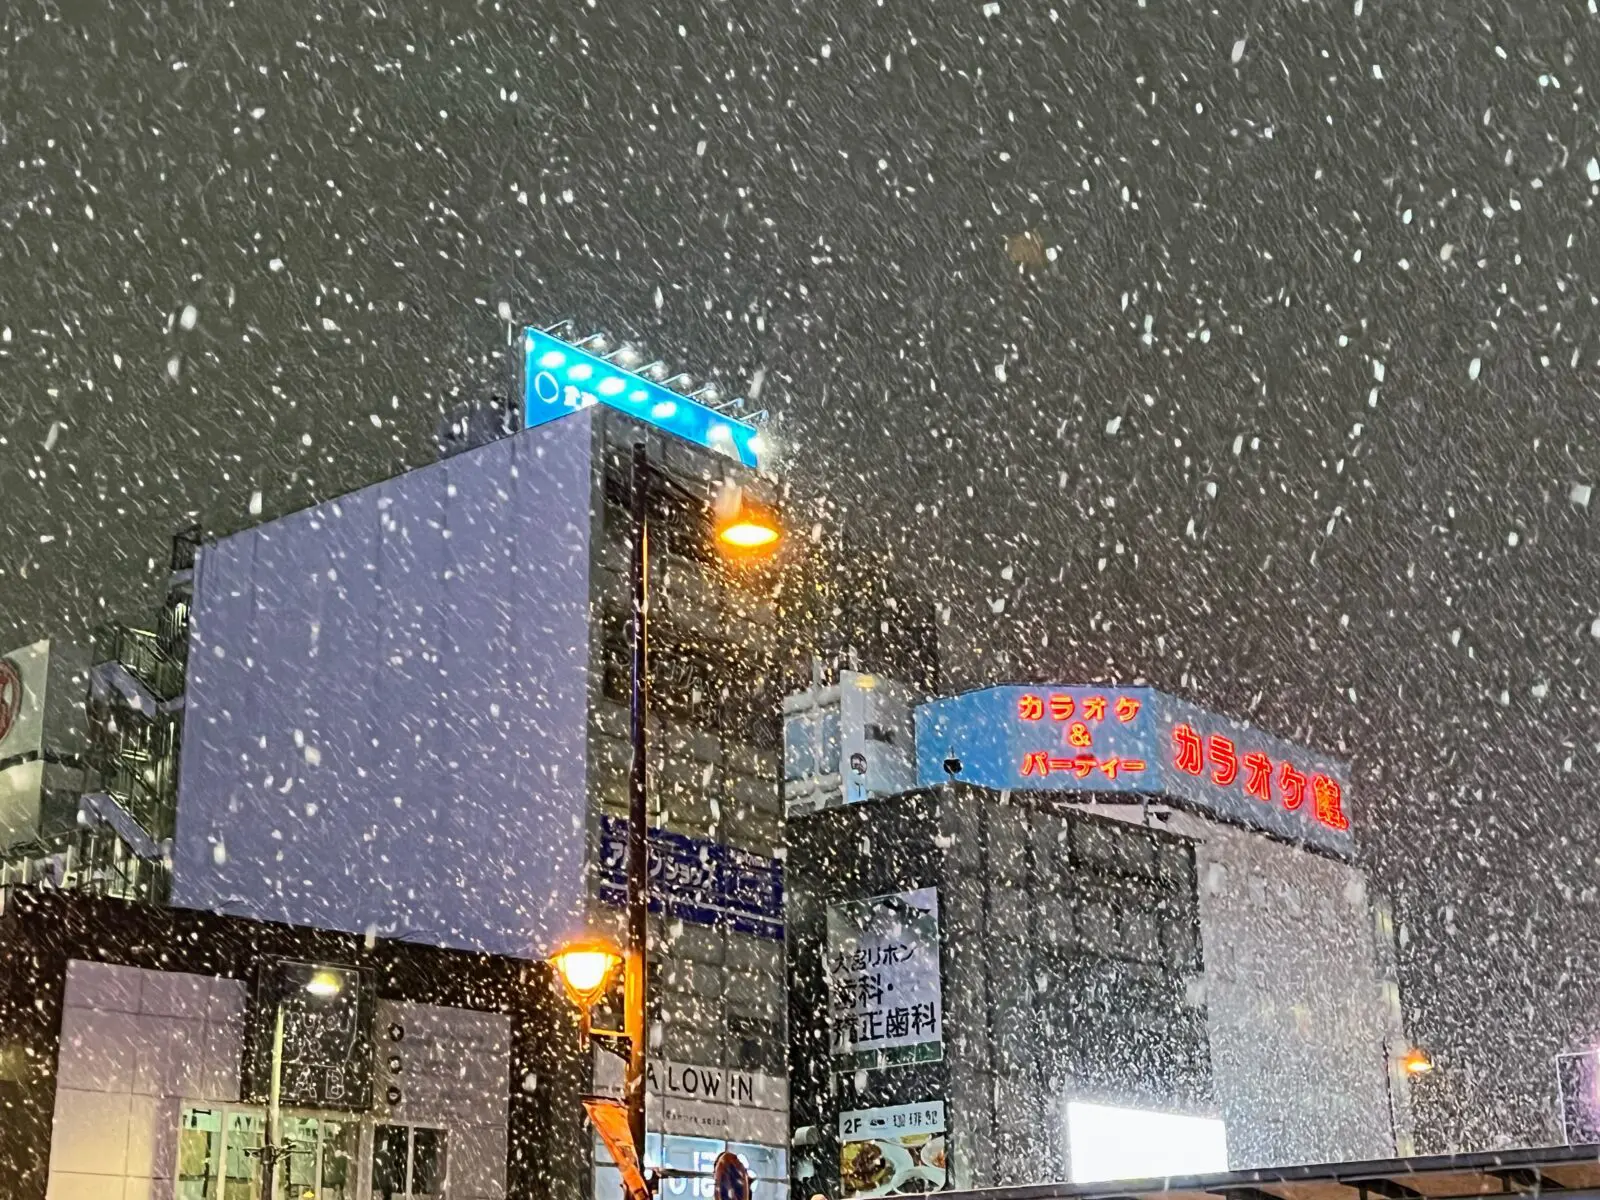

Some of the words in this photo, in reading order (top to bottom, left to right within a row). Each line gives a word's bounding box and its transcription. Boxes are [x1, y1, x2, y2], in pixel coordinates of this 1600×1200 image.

[1019, 693, 1141, 722] カラオケ
[1068, 721, 1091, 747] &
[1022, 751, 1147, 779] パーティー
[844, 1117, 862, 1134] 2F
